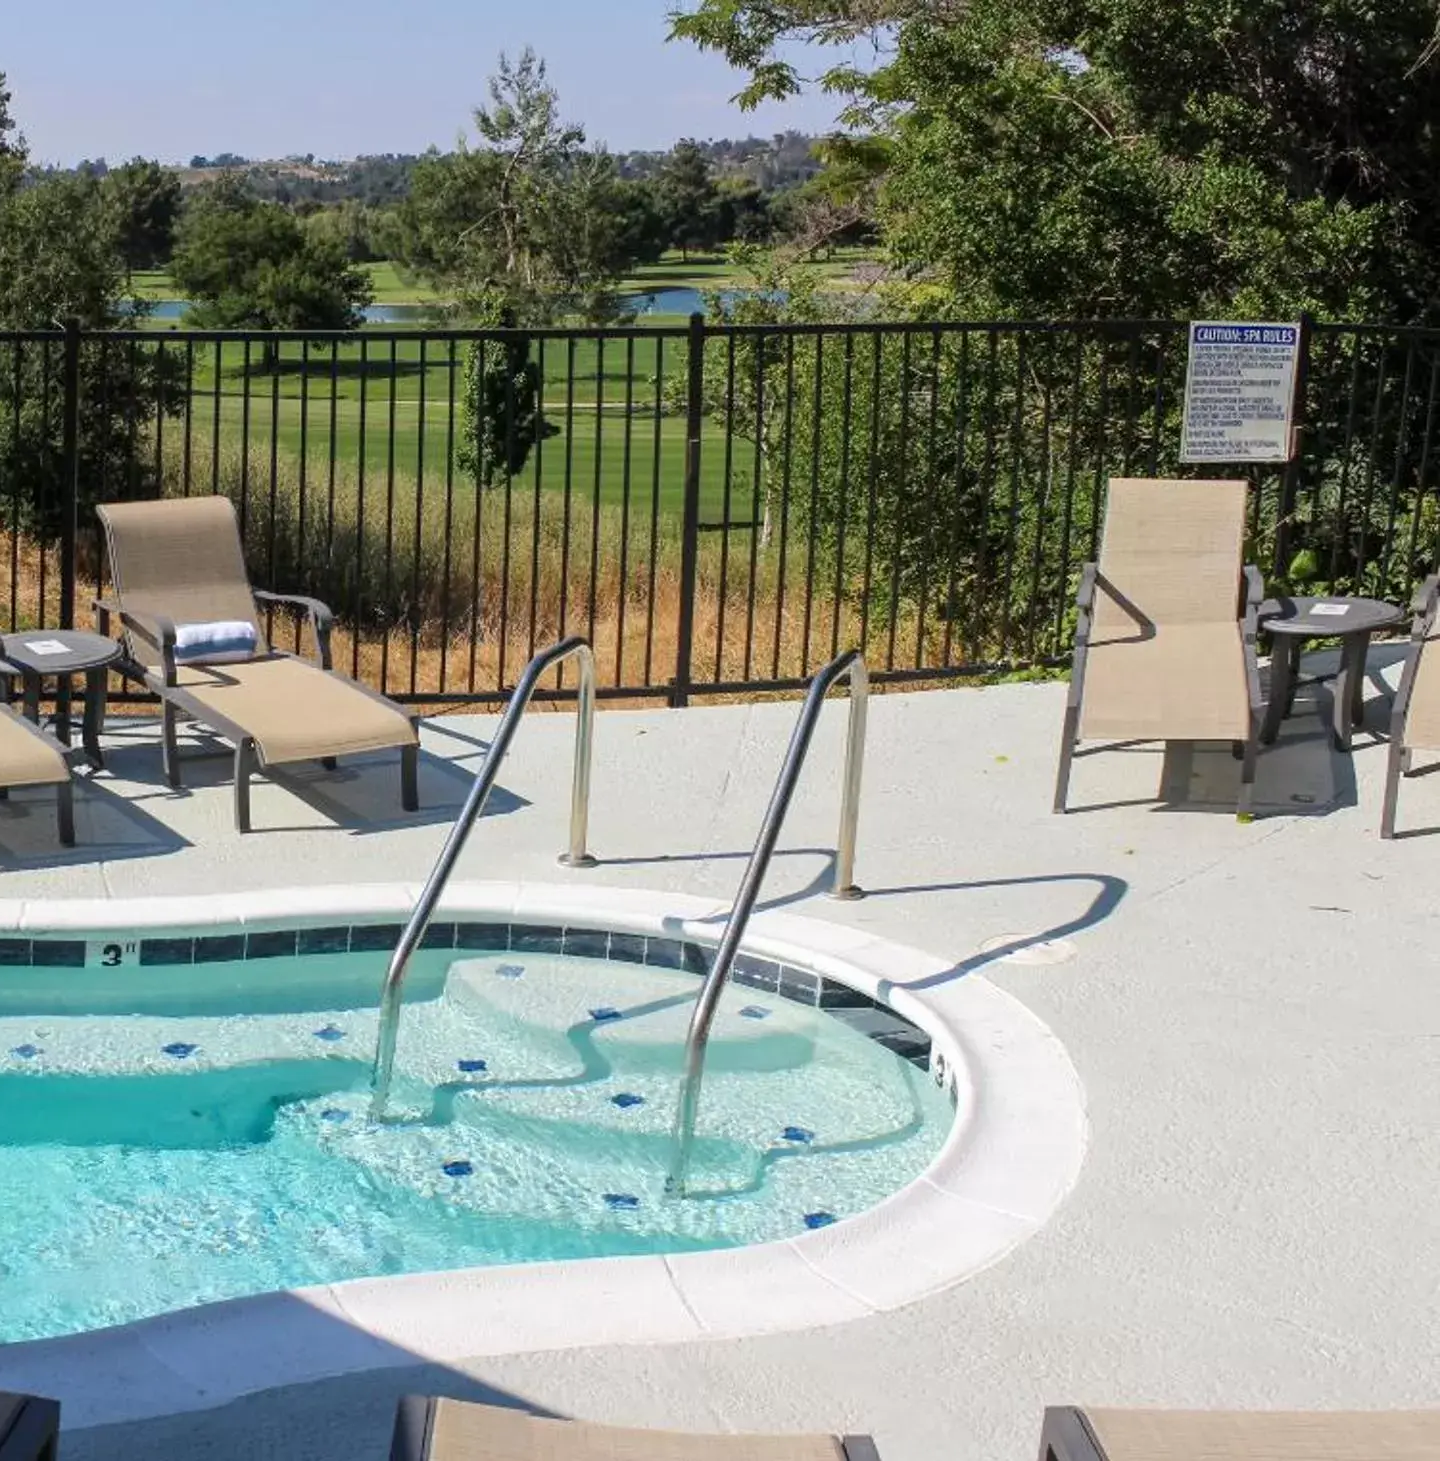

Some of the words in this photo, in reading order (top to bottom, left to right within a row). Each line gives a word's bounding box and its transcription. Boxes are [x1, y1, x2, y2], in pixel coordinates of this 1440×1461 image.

[1197, 327, 1241, 342] CAUTION:
[1244, 329, 1260, 342] SPA
[1263, 329, 1293, 343] RULES
